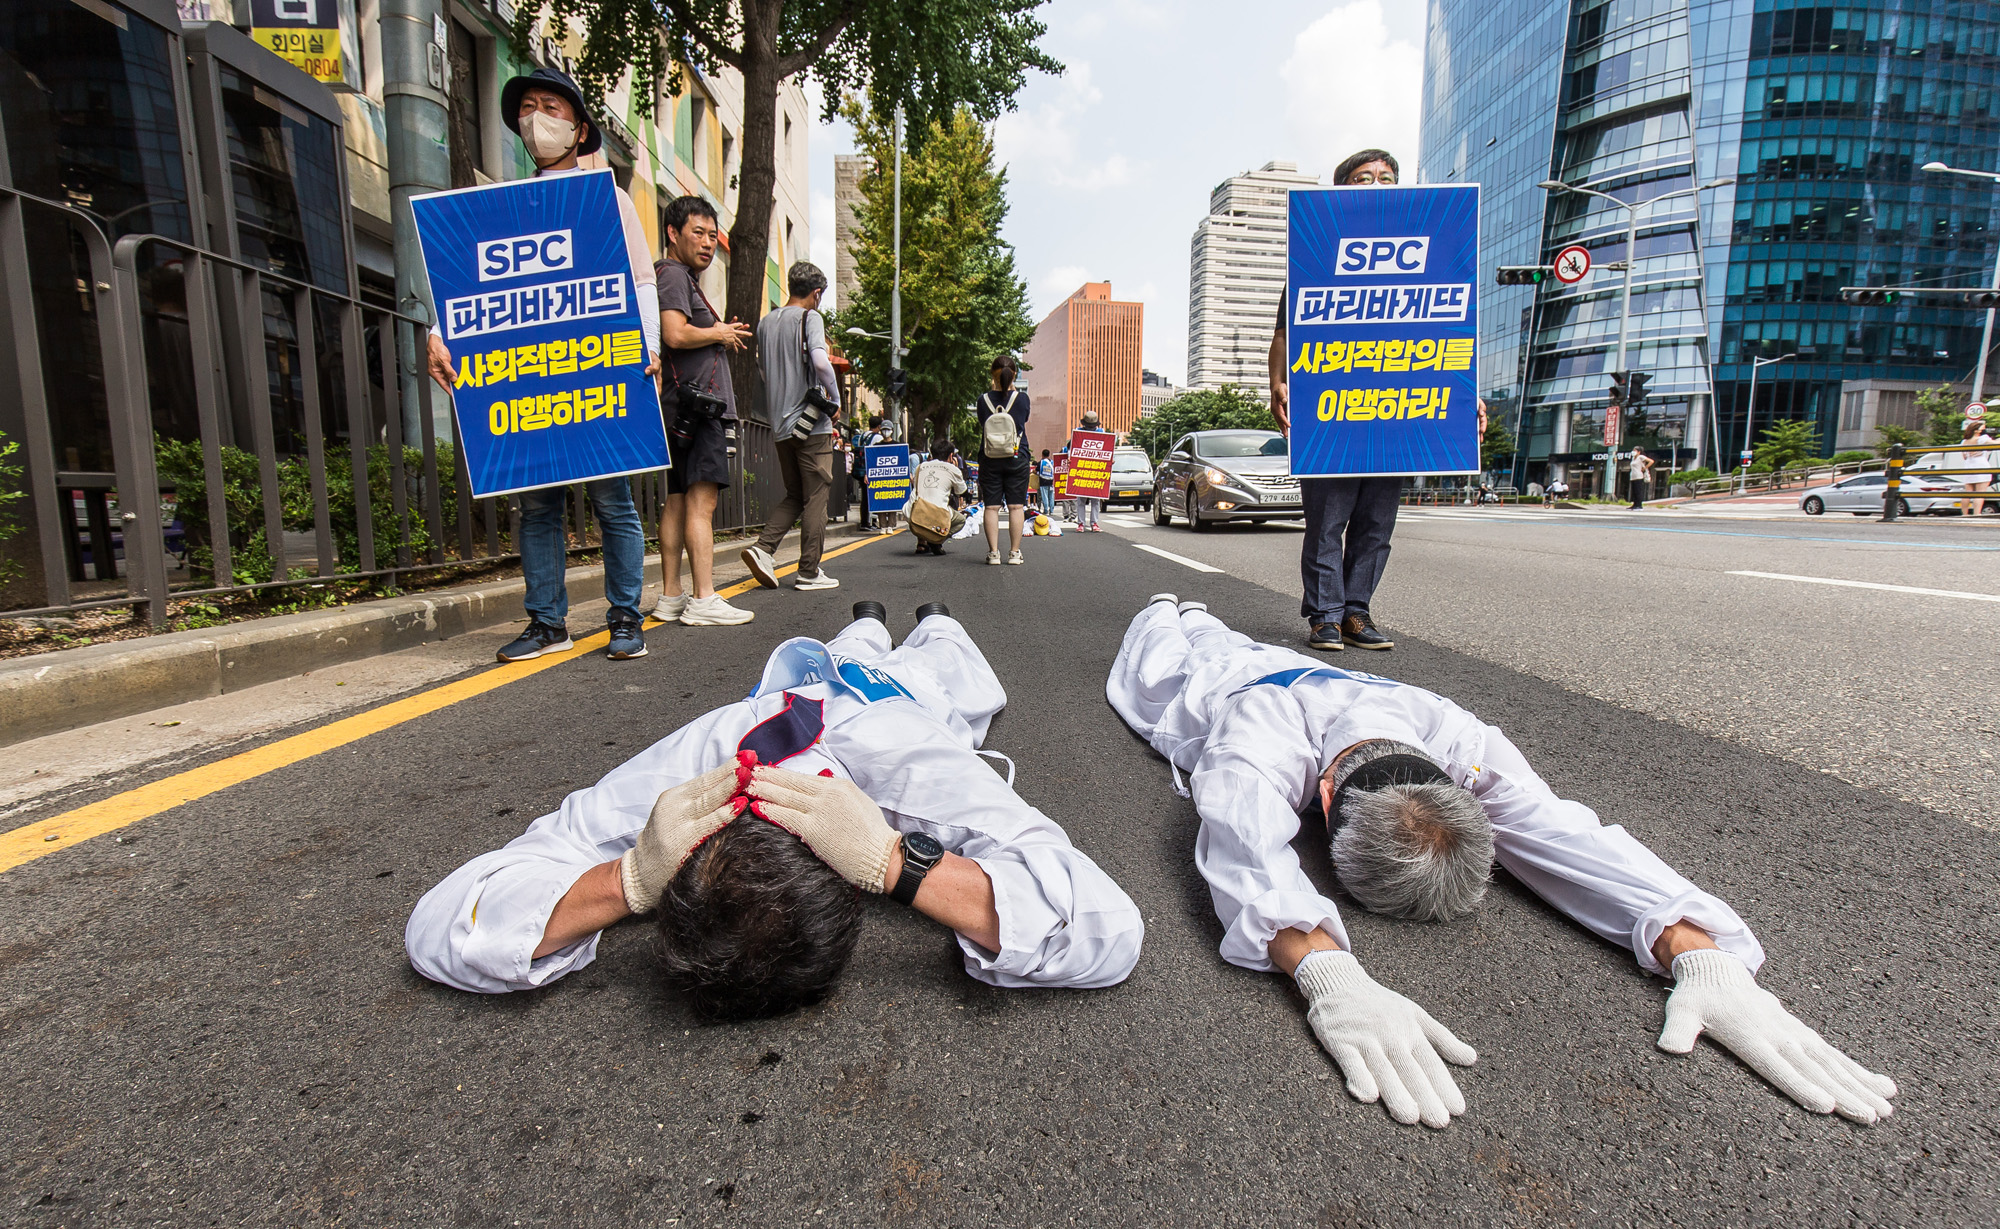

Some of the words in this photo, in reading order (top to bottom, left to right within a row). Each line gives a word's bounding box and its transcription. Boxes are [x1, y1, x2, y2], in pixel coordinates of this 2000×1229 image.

[271, 33, 324, 54] 회의실
[286, 58, 340, 77] -0804
[483, 234, 568, 277] SPC
[1341, 240, 1424, 272] SPC
[452, 277, 622, 335] 파리바게뜨
[1300, 286, 1465, 321] 파리바게뜨
[453, 329, 643, 390] 사회적합의를
[1290, 338, 1475, 374] 사회적합의를
[488, 382, 627, 436] 이행하라!
[1316, 386, 1451, 422] 이행하라!
[1969, 407, 1983, 416] 30
[1073, 448, 1111, 460] 파리바게뜨
[1083, 440, 1103, 449] SPC
[878, 457, 897, 465] SPC
[869, 467, 907, 476] 파리바게뜨
[868, 478, 910, 489] 사회적합의를
[874, 490, 906, 500] 이행하라!
[1280, 494, 1300, 502] 4460
